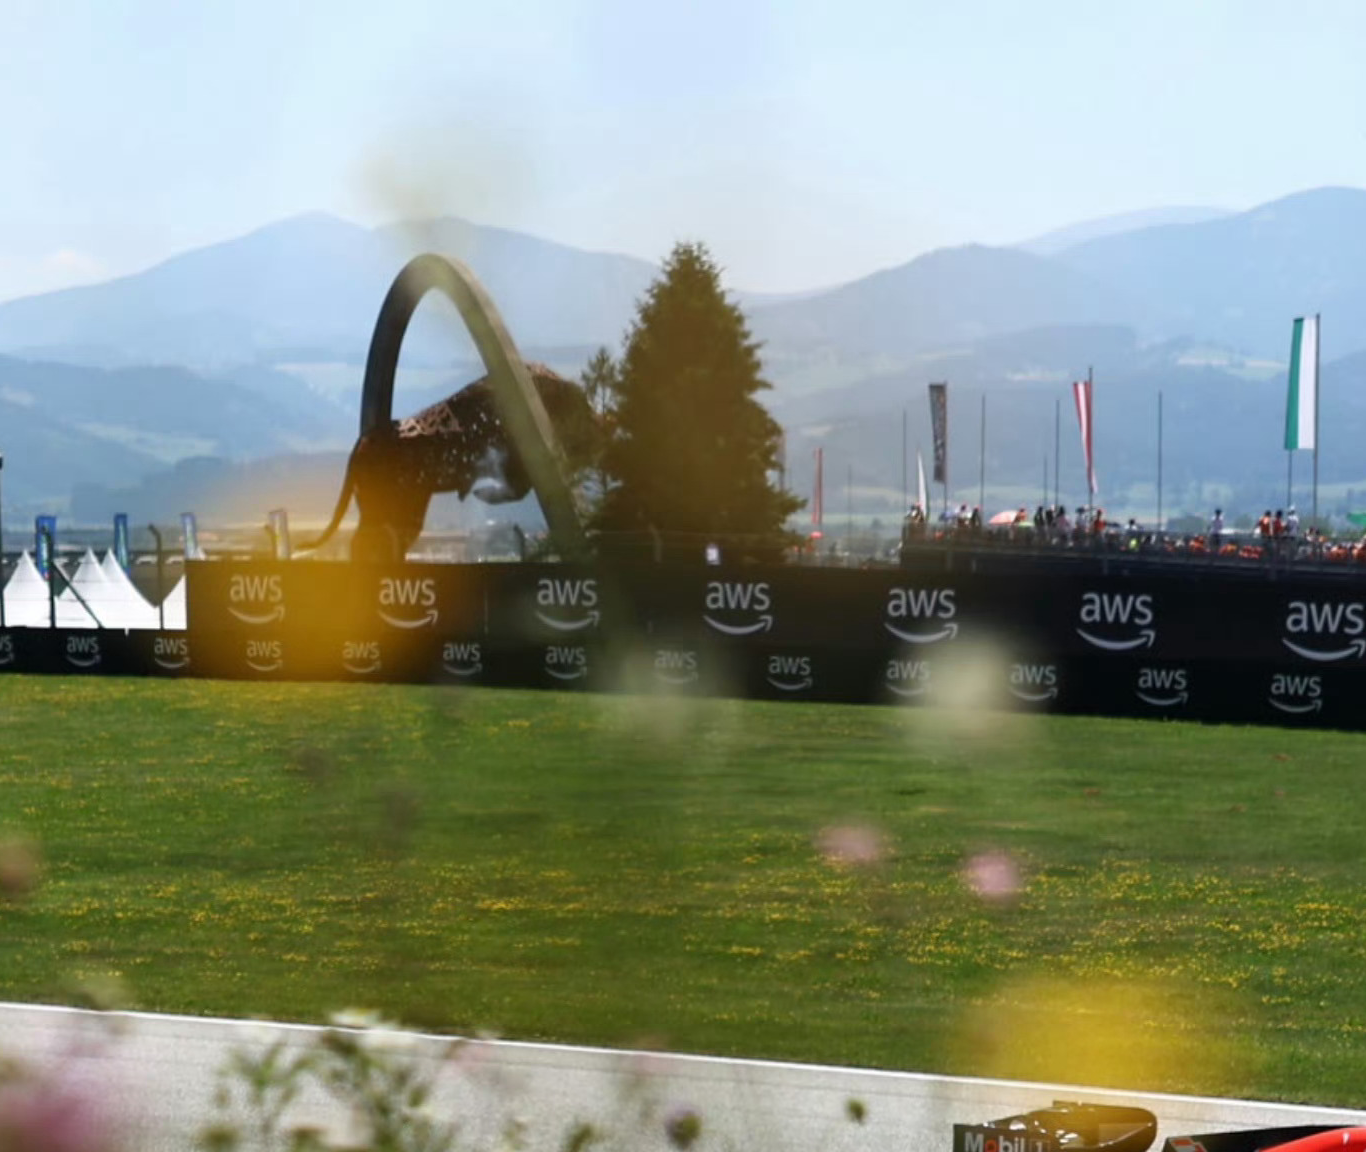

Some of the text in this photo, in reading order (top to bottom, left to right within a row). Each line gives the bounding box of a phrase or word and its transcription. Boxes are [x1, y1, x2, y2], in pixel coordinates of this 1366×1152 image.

[230, 574, 282, 601] aws
[380, 576, 436, 605] aws
[537, 578, 597, 606] aws
[706, 582, 771, 609] aws
[887, 589, 955, 618] aws
[1080, 593, 1153, 624] aws
[1286, 602, 1364, 633] aws
[66, 636, 99, 653] aws
[154, 638, 187, 655] aws
[247, 641, 282, 658] aws
[343, 641, 379, 659] aws
[443, 643, 480, 662] aws
[545, 646, 585, 665] aws
[655, 649, 696, 669] aws
[769, 656, 811, 676] aws
[887, 660, 929, 681] aws
[1011, 664, 1056, 686] aws
[1138, 668, 1187, 690] aws
[1271, 674, 1321, 697] aws
